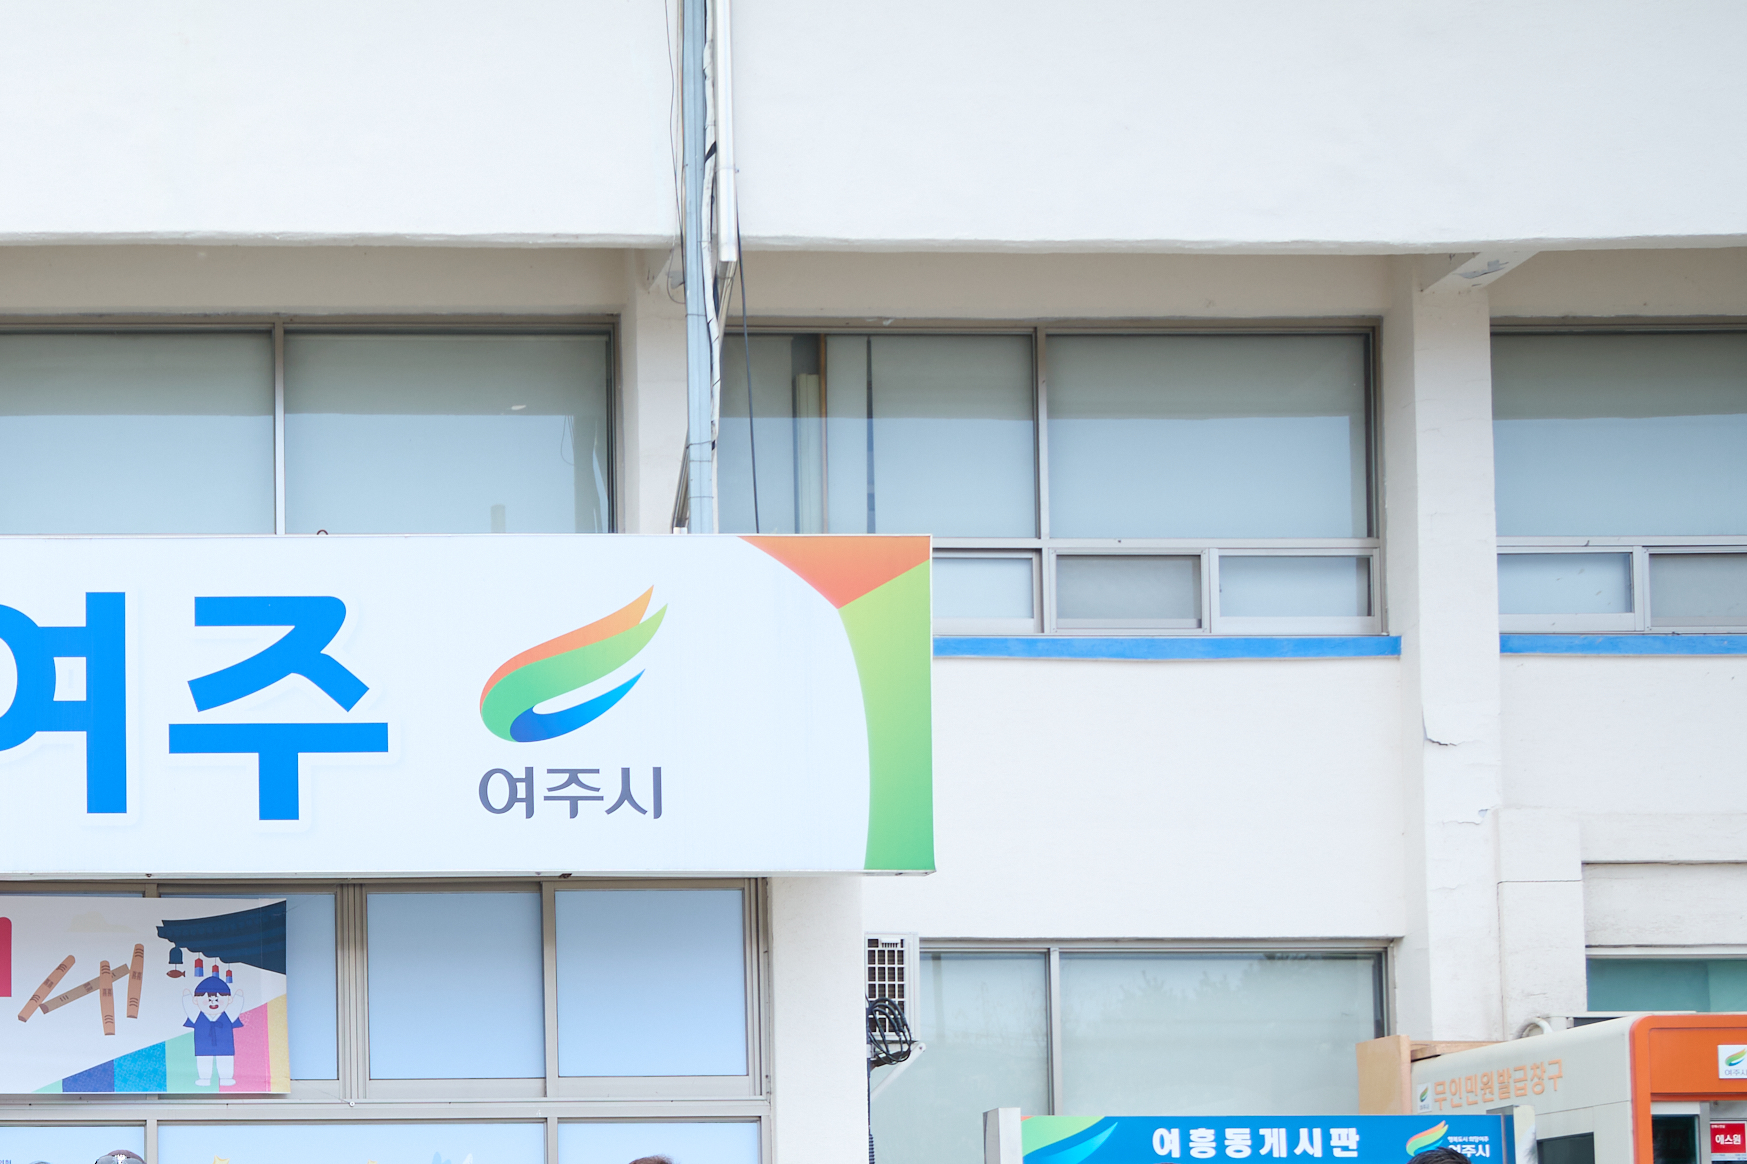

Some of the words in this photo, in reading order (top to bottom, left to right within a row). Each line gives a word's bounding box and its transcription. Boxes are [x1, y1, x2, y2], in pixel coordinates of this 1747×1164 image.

[477, 764, 664, 820] 여주시
[1433, 1058, 1564, 1111] 무인민원발급창구
[1715, 1134, 1742, 1145] 에스원
